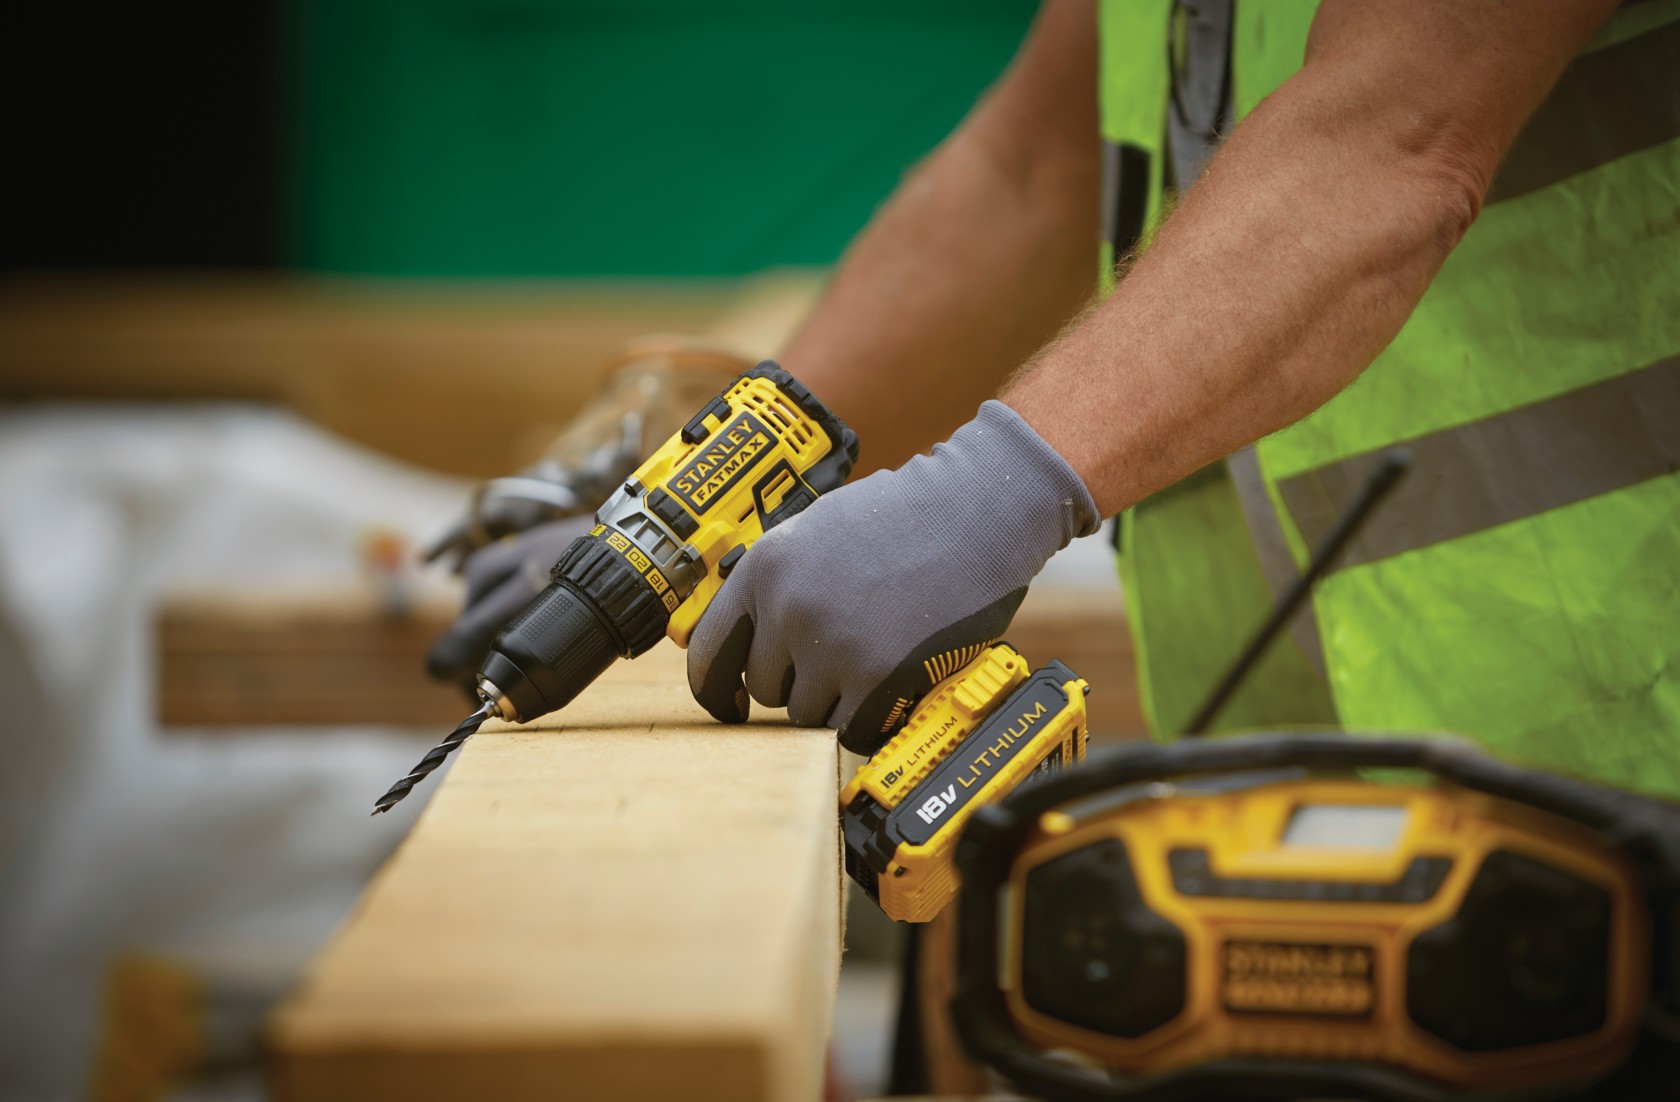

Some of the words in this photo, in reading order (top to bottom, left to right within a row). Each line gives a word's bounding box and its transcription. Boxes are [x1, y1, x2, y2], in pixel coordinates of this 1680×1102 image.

[675, 417, 753, 494] STANLEY
[696, 438, 763, 501] FATMAX
[609, 534, 627, 550] 22
[629, 551, 648, 570] 20
[649, 573, 664, 590] 18
[907, 715, 958, 766] LITHIUM
[957, 701, 1048, 789] LITHIUM
